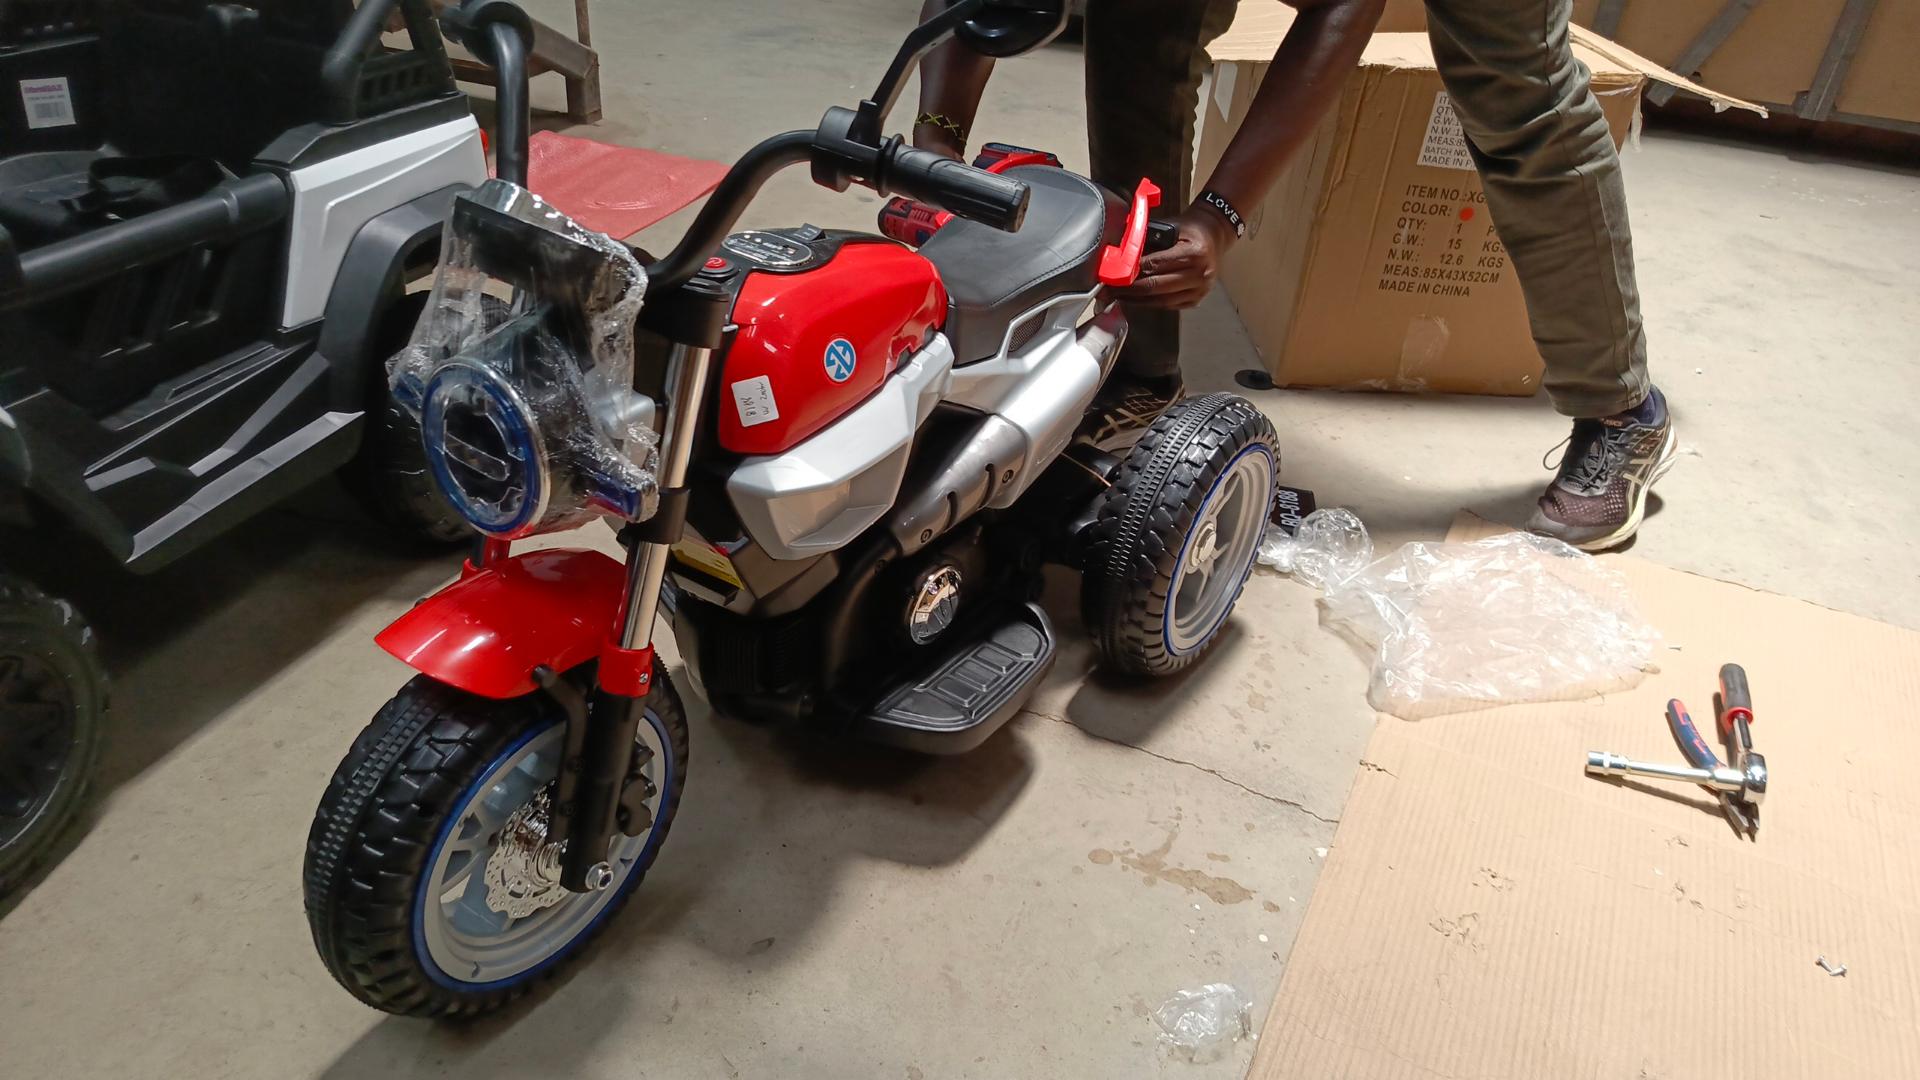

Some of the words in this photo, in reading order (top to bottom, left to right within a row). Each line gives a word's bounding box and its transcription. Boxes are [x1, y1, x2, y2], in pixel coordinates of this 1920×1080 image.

[1424, 145, 1452, 156] BATCH
[1421, 155, 1451, 166] MADE
[1452, 159, 1463, 167] IN
[1405, 184, 1438, 199] ITEM
[1440, 188, 1486, 204] NO.:XG
[1206, 192, 1240, 225] LOVE
[1401, 201, 1452, 217] COLOR:
[1396, 217, 1427, 231] QTY:
[1456, 223, 1463, 234] 1
[1486, 225, 1495, 236] P
[1392, 233, 1425, 247] G.W.:
[1448, 238, 1462, 250] 15
[1387, 248, 1420, 262] N.W.:
[1440, 253, 1464, 266] 12.6
[1477, 256, 1504, 269] KGS
[1383, 264, 1500, 284] MEAS:85X43X52CM
[1378, 279, 1416, 293] MADE
[1417, 282, 1430, 294] IN
[1432, 284, 1470, 297] CHINA
